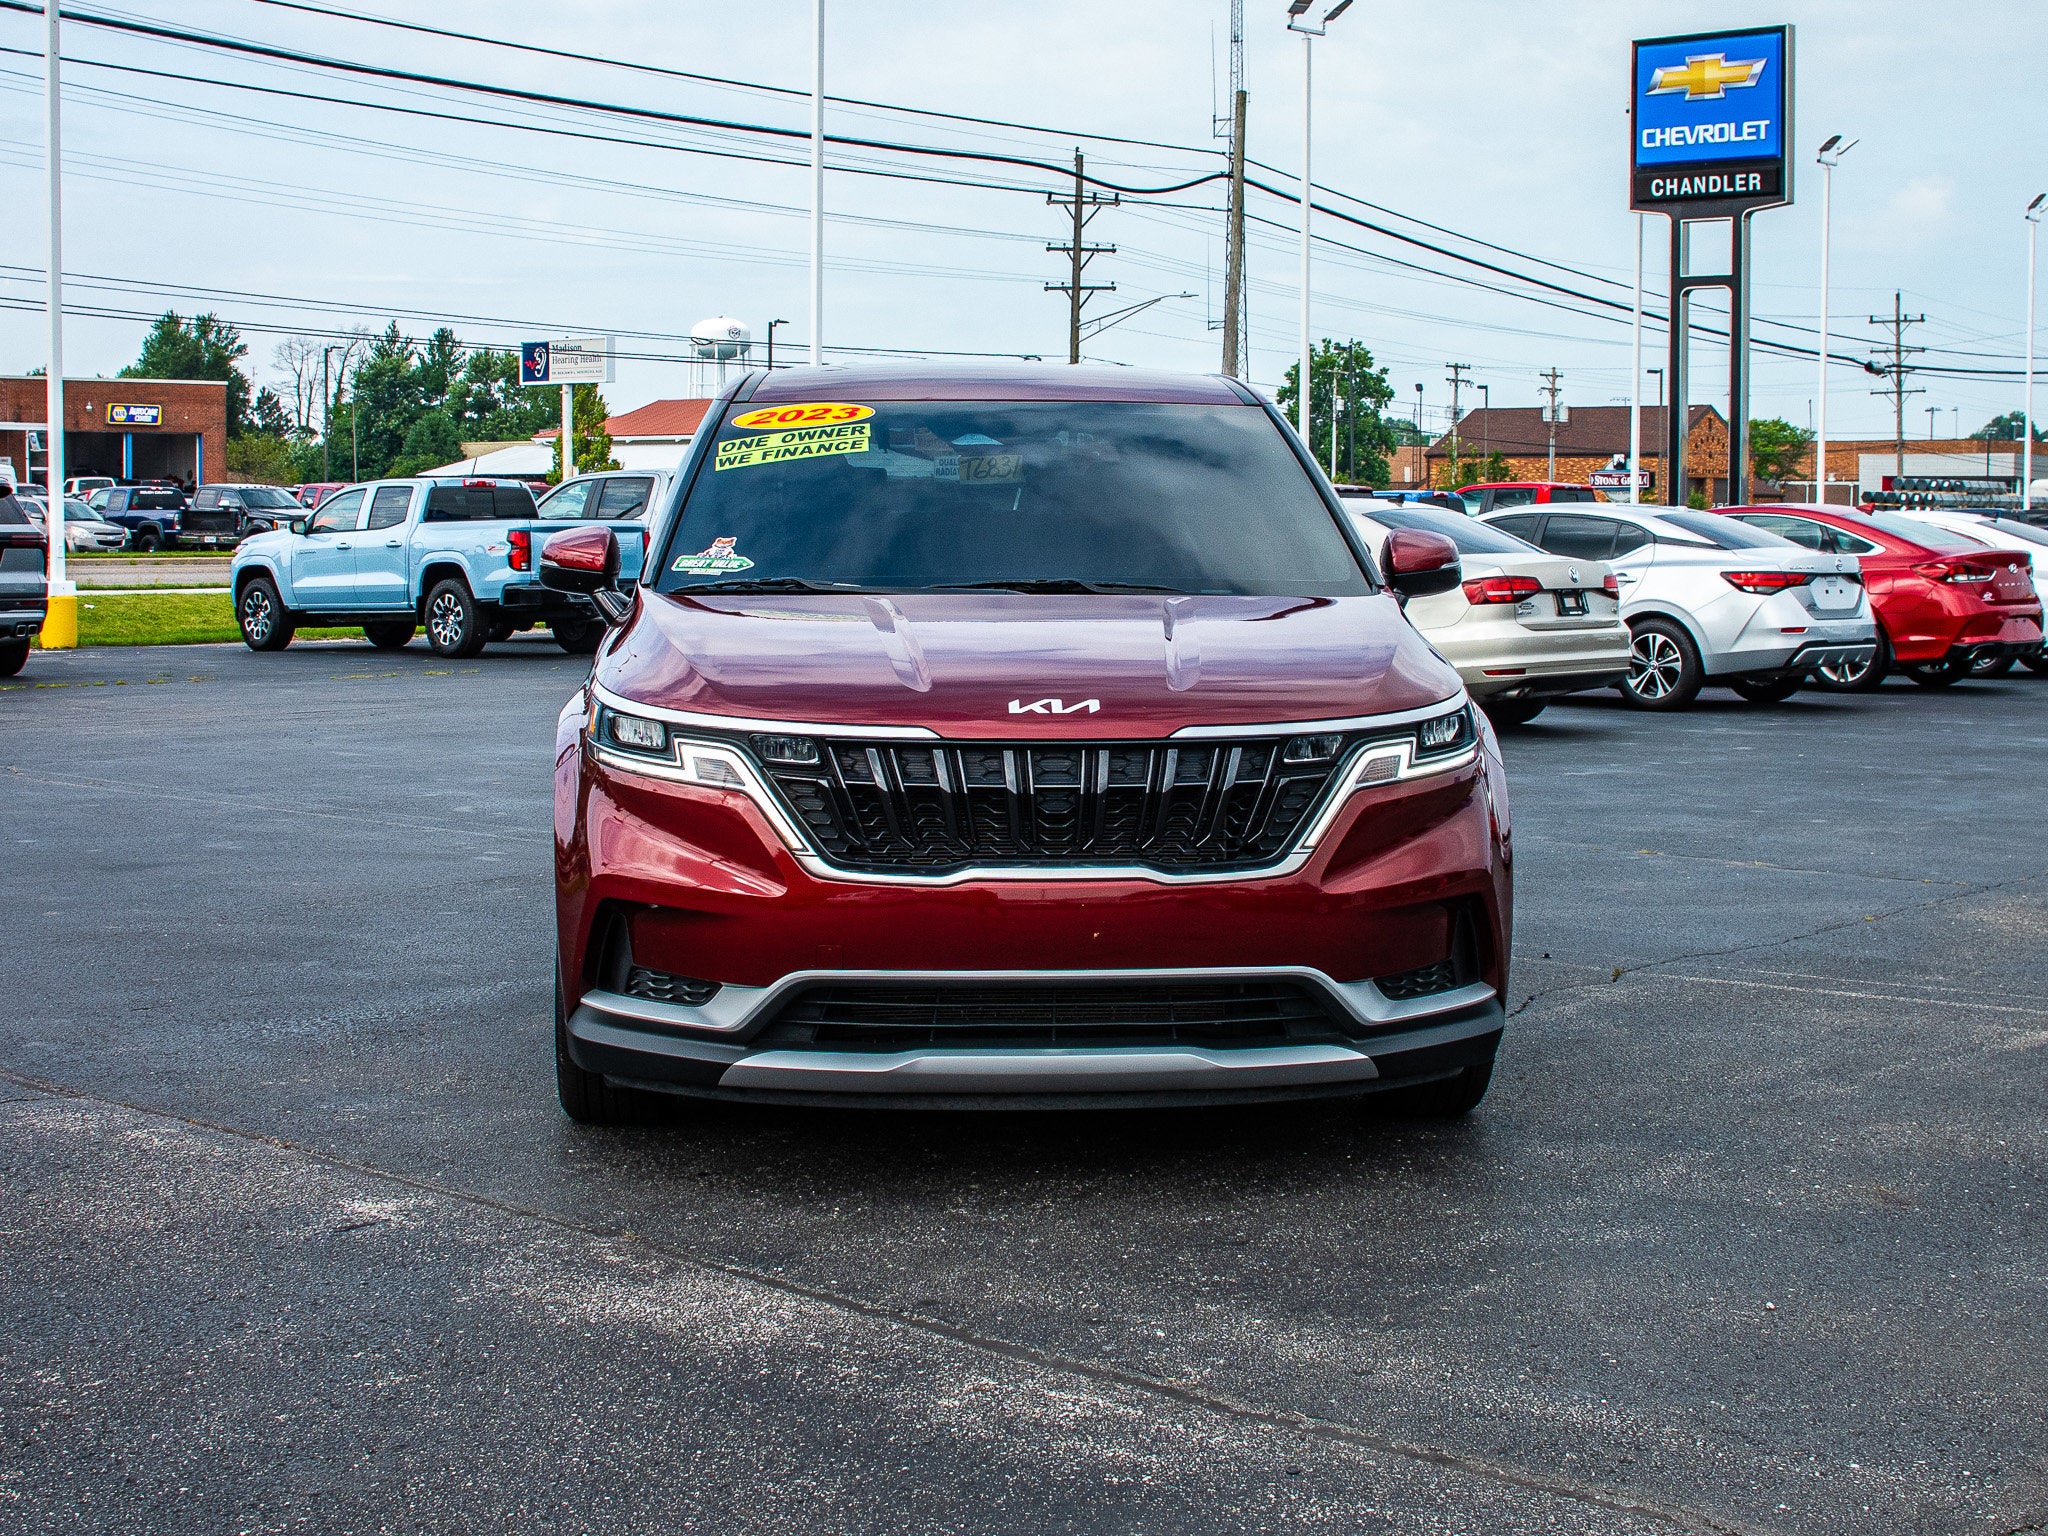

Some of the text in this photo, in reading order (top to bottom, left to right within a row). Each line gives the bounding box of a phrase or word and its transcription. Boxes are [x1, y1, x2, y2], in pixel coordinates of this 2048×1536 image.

[1641, 119, 1771, 149] CHEVROLET
[1650, 172, 1762, 197] CHANDLER
[551, 343, 582, 352] Madison
[552, 353, 602, 365] Hearing Health
[746, 407, 862, 426] 2023
[721, 425, 866, 453] ONE OWNER
[718, 440, 865, 468] WE FINANCE
[934, 467, 960, 476] RADIA
[1594, 475, 1644, 486] STONE GRL
[678, 559, 743, 569] GREAT VALUE
